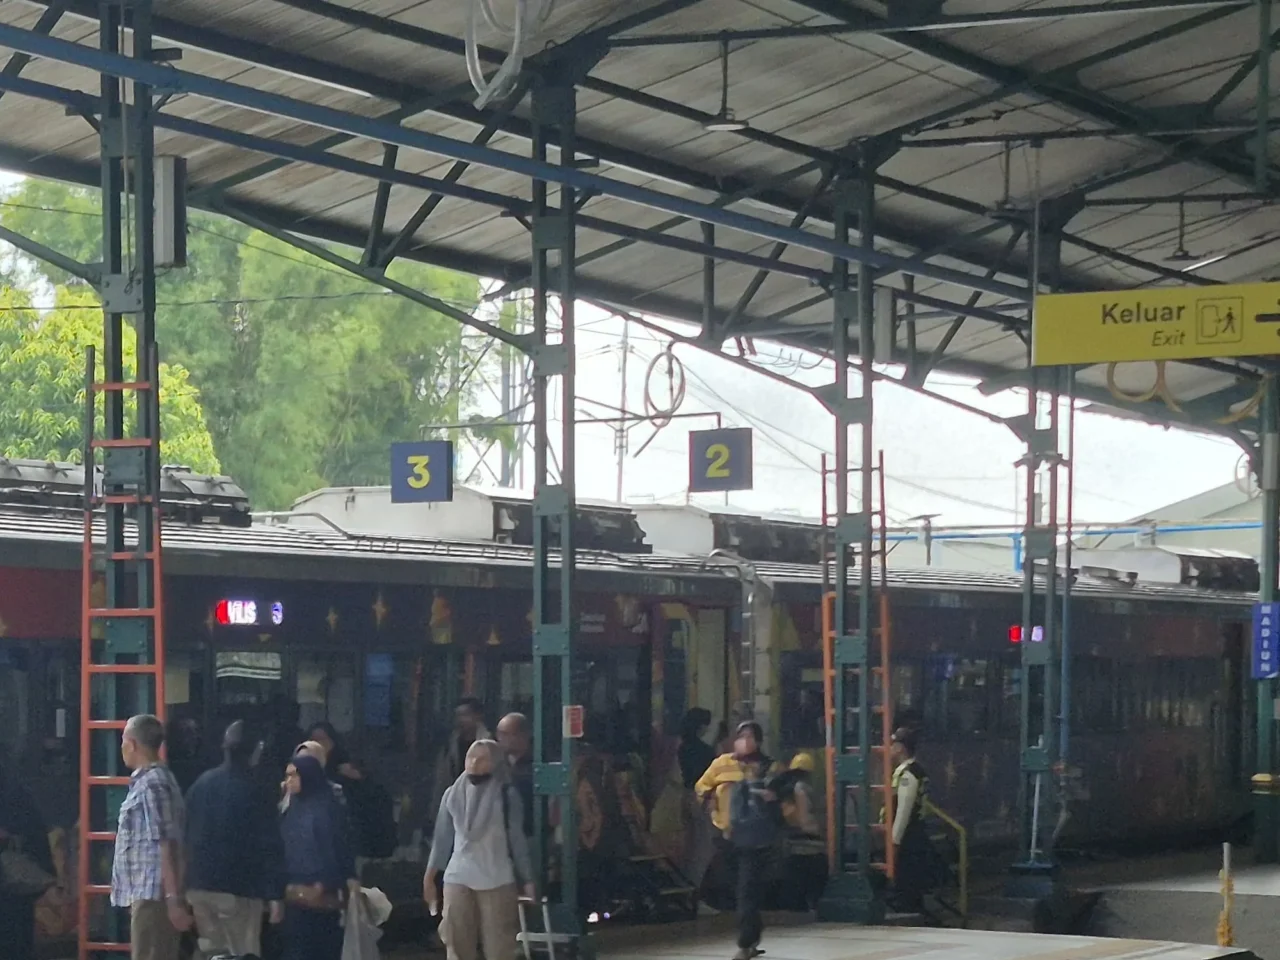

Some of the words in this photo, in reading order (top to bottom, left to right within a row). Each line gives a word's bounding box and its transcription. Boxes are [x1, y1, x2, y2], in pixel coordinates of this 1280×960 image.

[1102, 302, 1185, 324] Keluar
[1151, 329, 1186, 347] Exit
[407, 455, 431, 489] 3
[704, 443, 730, 478] 2
